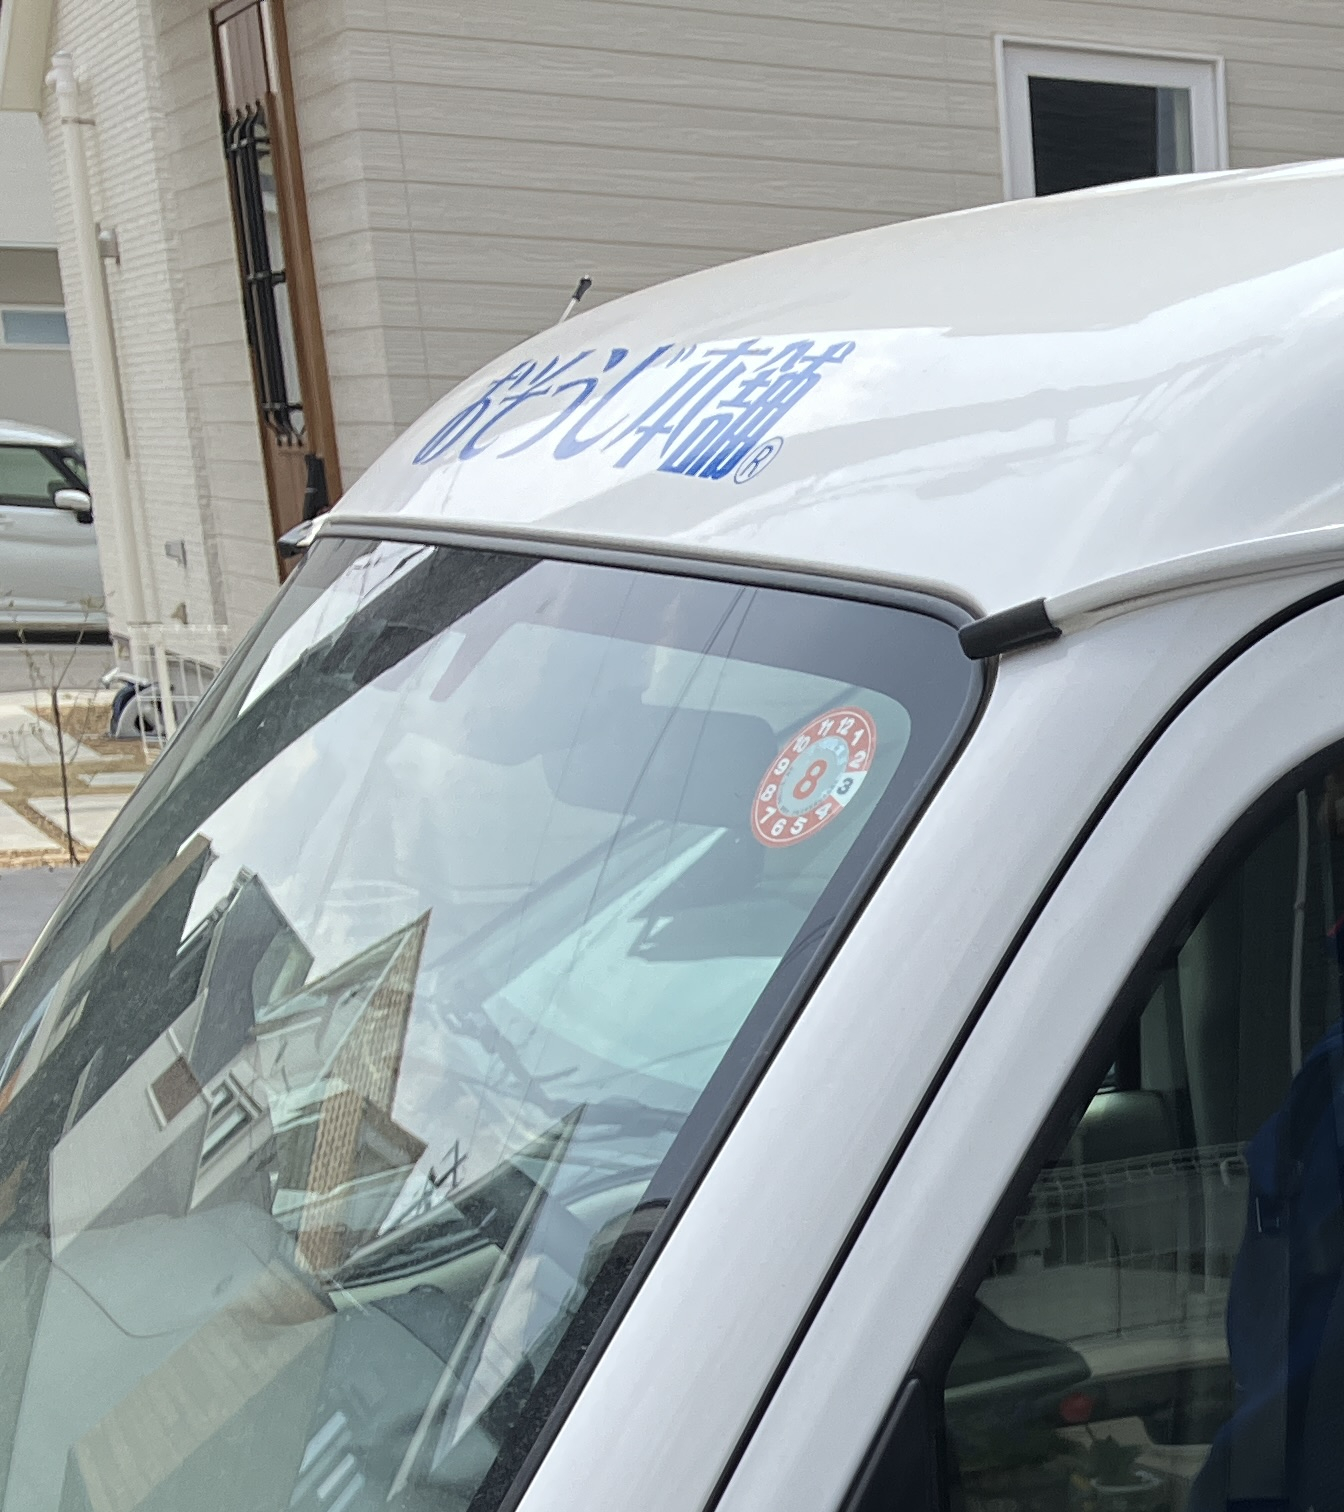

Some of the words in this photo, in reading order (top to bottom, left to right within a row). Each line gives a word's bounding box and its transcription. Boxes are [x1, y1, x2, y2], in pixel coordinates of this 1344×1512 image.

[817, 719, 834, 736] 11
[836, 717, 855, 736] 12
[792, 734, 811, 753] 10
[852, 728, 865, 746] 1
[774, 758, 790, 776] 9
[849, 751, 867, 769] 2
[792, 759, 828, 800] 8
[836, 778, 854, 796] 3
[760, 784, 777, 801] 8
[760, 807, 776, 824] 7
[815, 803, 833, 820] 4
[770, 818, 787, 836] 6
[790, 817, 808, 835] 5
